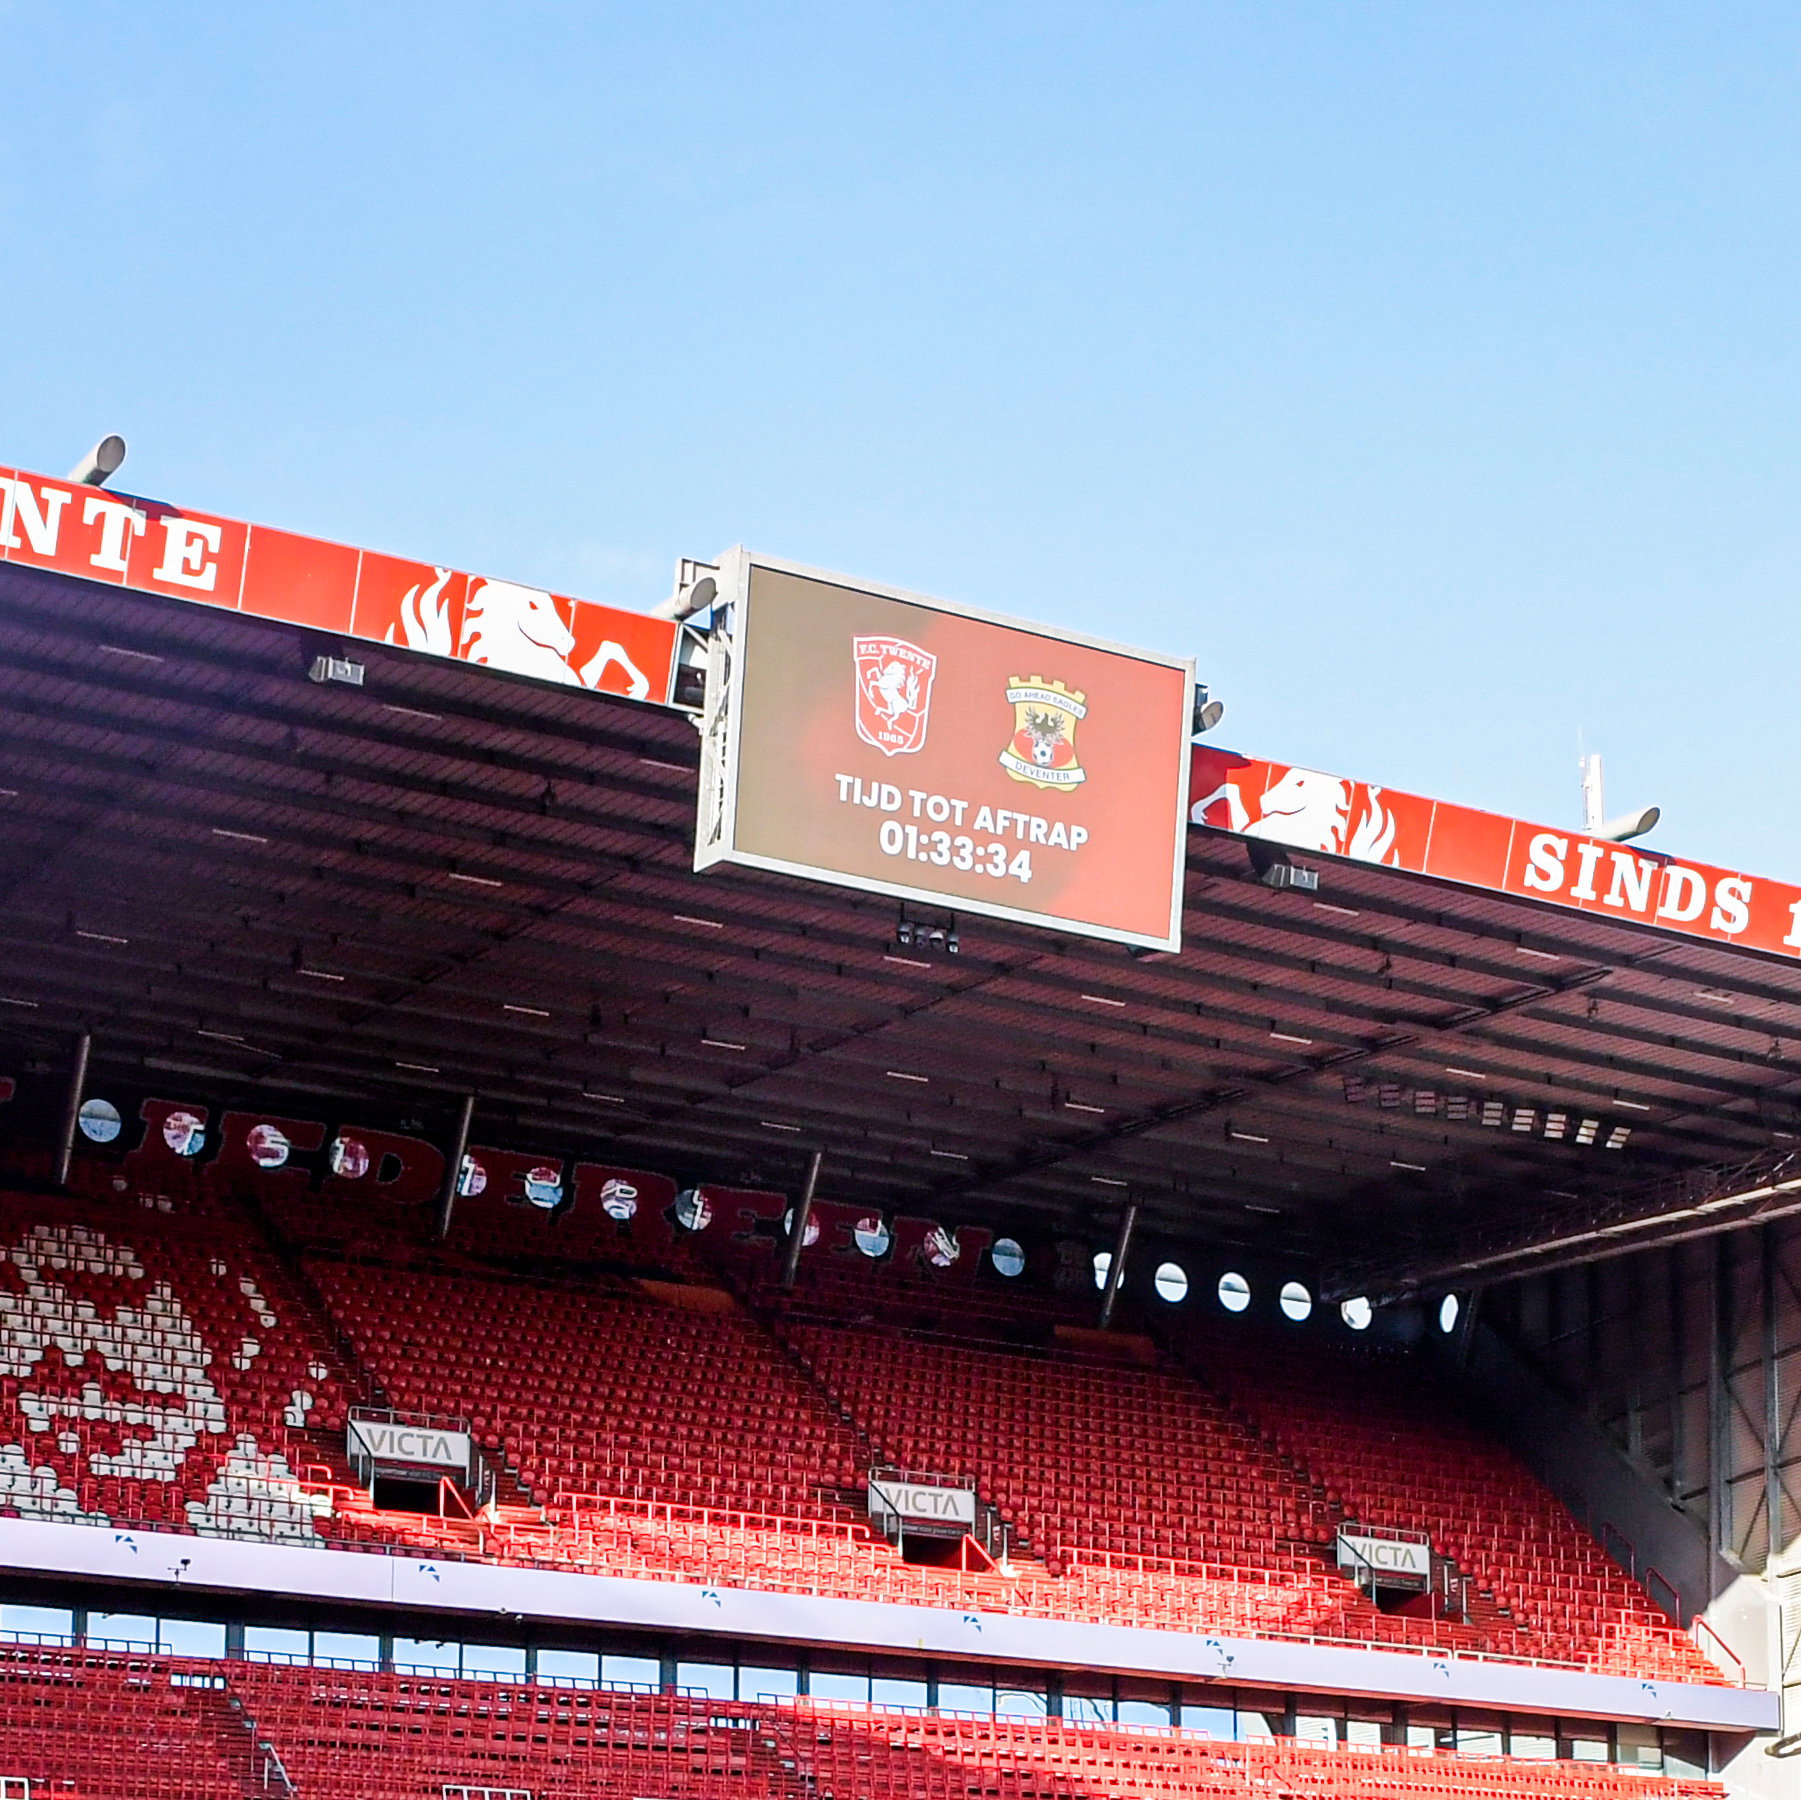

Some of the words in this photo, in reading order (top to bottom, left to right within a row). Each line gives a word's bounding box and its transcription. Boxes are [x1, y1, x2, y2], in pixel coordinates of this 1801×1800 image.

[880, 645, 932, 670] TWENTE
[1009, 691, 1022, 700] GO
[1024, 692, 1051, 704] AHEAD
[1052, 697, 1084, 717] EAGLES
[1016, 761, 1070, 782] DEVENTER
[833, 773, 902, 812] TIJD
[908, 789, 969, 827] TOT
[974, 804, 1089, 852] AFTRAP
[879, 820, 1032, 884] 01:33:34
[1525, 833, 1753, 936] SINDS
[367, 1429, 452, 1460] VICTA
[885, 1488, 959, 1516] VICTA
[1352, 1542, 1416, 1568] VICTA
